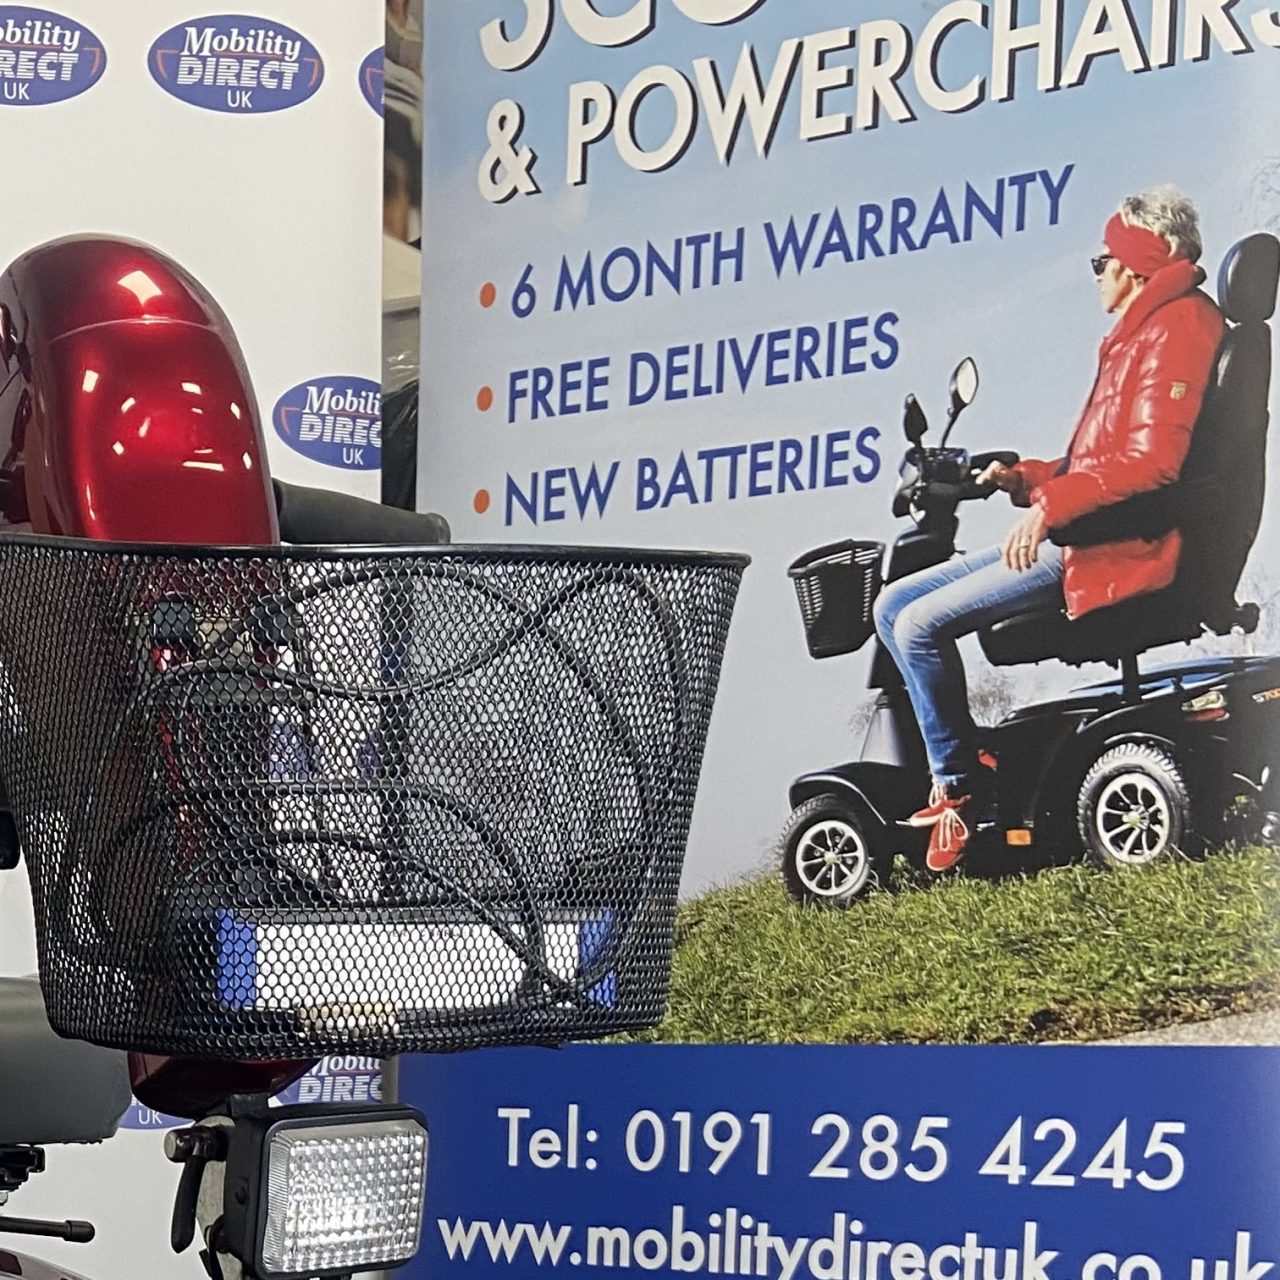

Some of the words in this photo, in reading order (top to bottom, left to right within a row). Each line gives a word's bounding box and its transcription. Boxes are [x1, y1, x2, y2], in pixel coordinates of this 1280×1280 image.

[180, 26, 301, 61] Mobility
[177, 57, 299, 90] DIRECT
[4, 82, 30, 100] UK
[227, 89, 253, 108] UK
[477, 99, 542, 204] &
[566, 0, 1280, 186] POWERCHAIR
[511, 262, 536, 318] 6
[554, 226, 746, 311] MONTH
[764, 164, 1076, 279] WARRANTY
[507, 356, 611, 424] FREE
[629, 311, 900, 402] DELIVERIES
[302, 386, 381, 415] Mobili
[299, 414, 381, 448] DIREC
[343, 447, 364, 465] UK
[504, 460, 619, 526] NEW
[634, 425, 881, 512] BATTERIES
[298, 1075, 382, 1102] DIREC
[497, 1105, 599, 1171] Tel:
[625, 1110, 771, 1177] 0191
[809, 1113, 950, 1184] 285
[978, 1115, 1186, 1191] 4245
